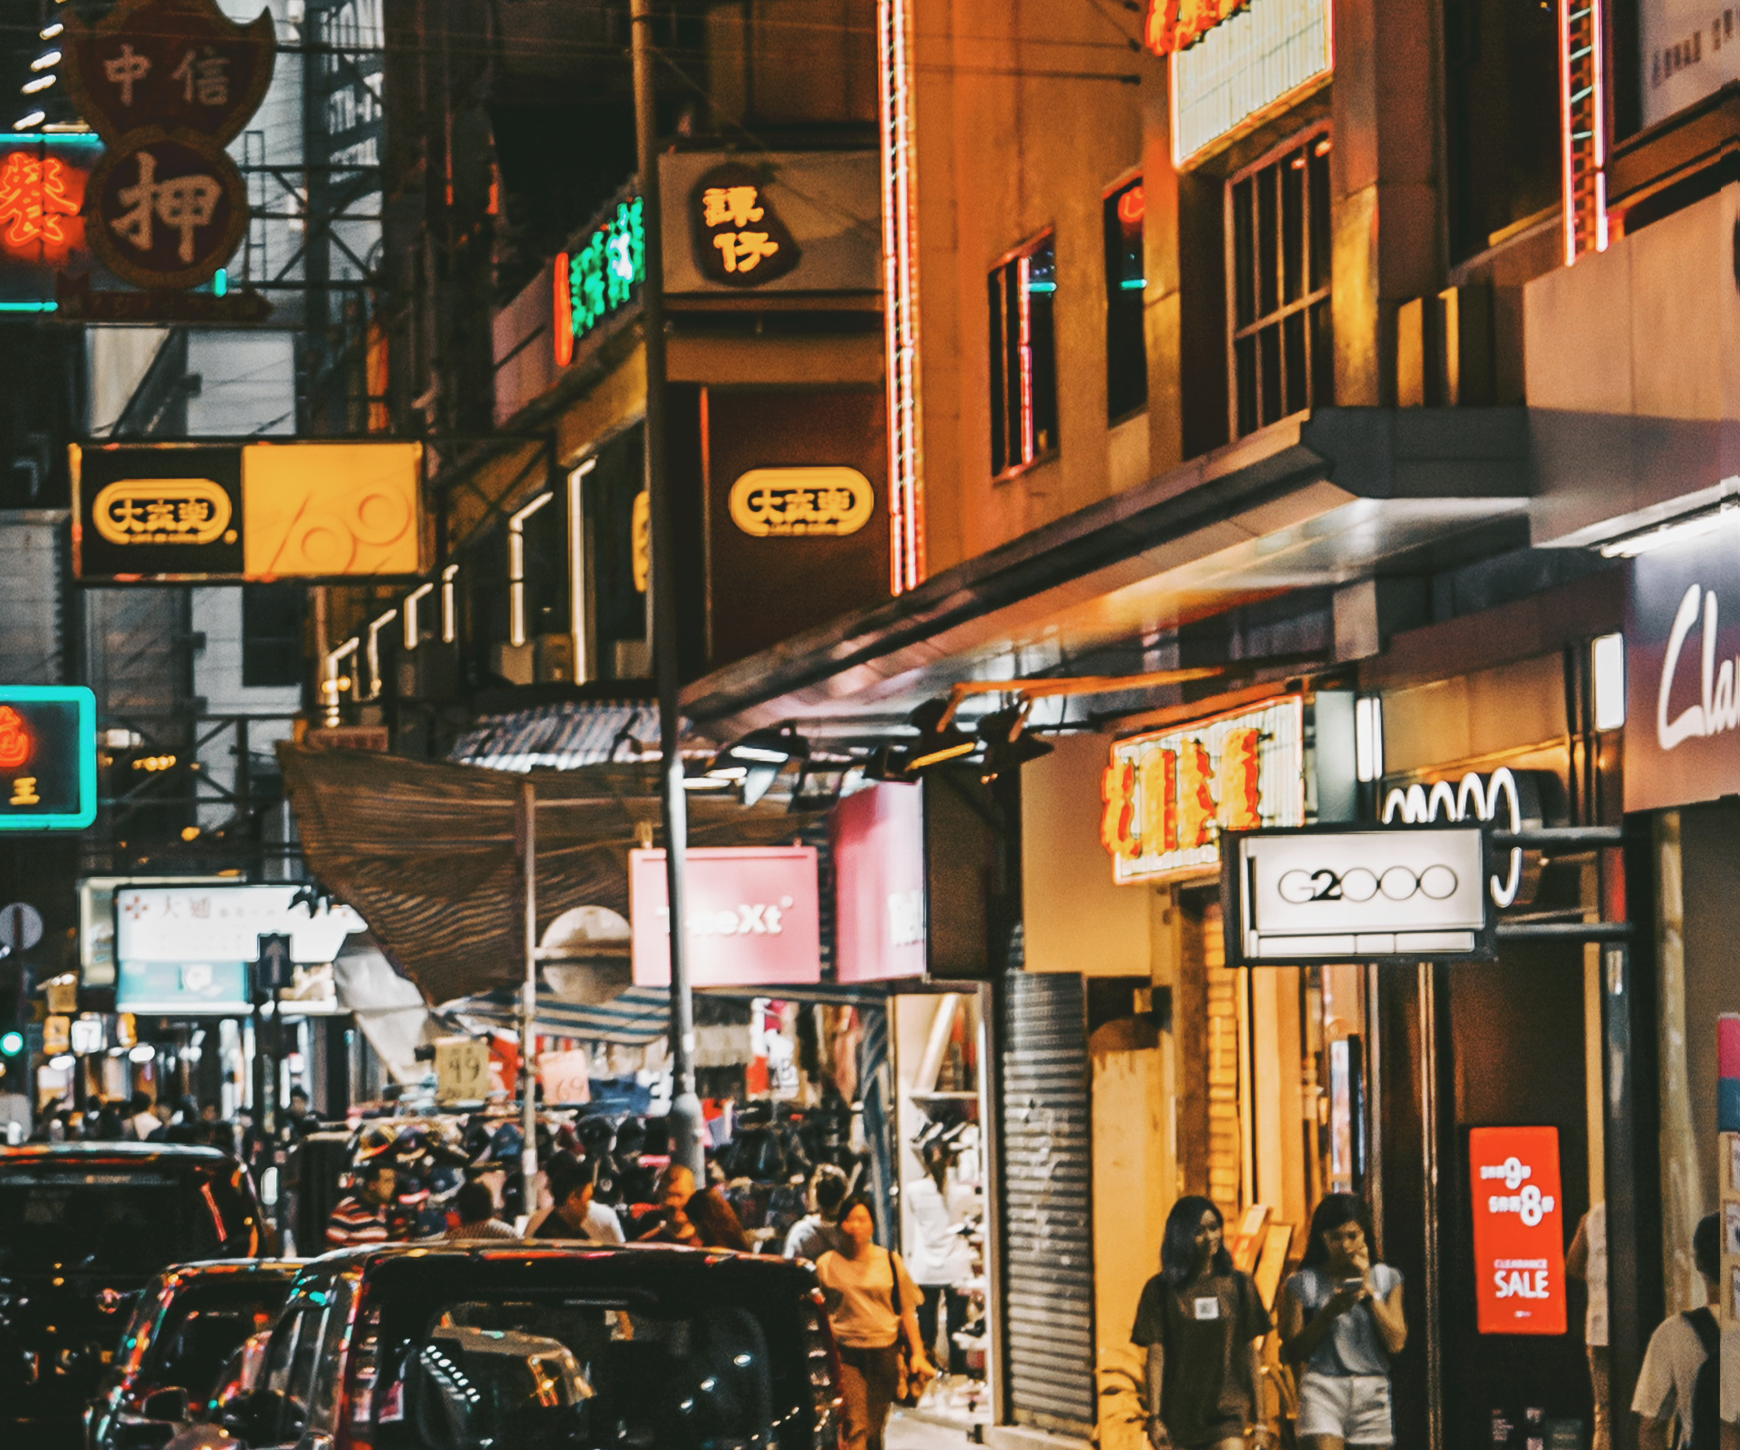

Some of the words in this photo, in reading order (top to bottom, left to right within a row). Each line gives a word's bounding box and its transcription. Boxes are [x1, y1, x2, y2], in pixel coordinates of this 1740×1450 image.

[102, 43, 232, 106] 中信
[110, 152, 224, 263] 押
[1278, 863, 1459, 904] G2000
[1494, 1270, 1551, 1299] SALE
